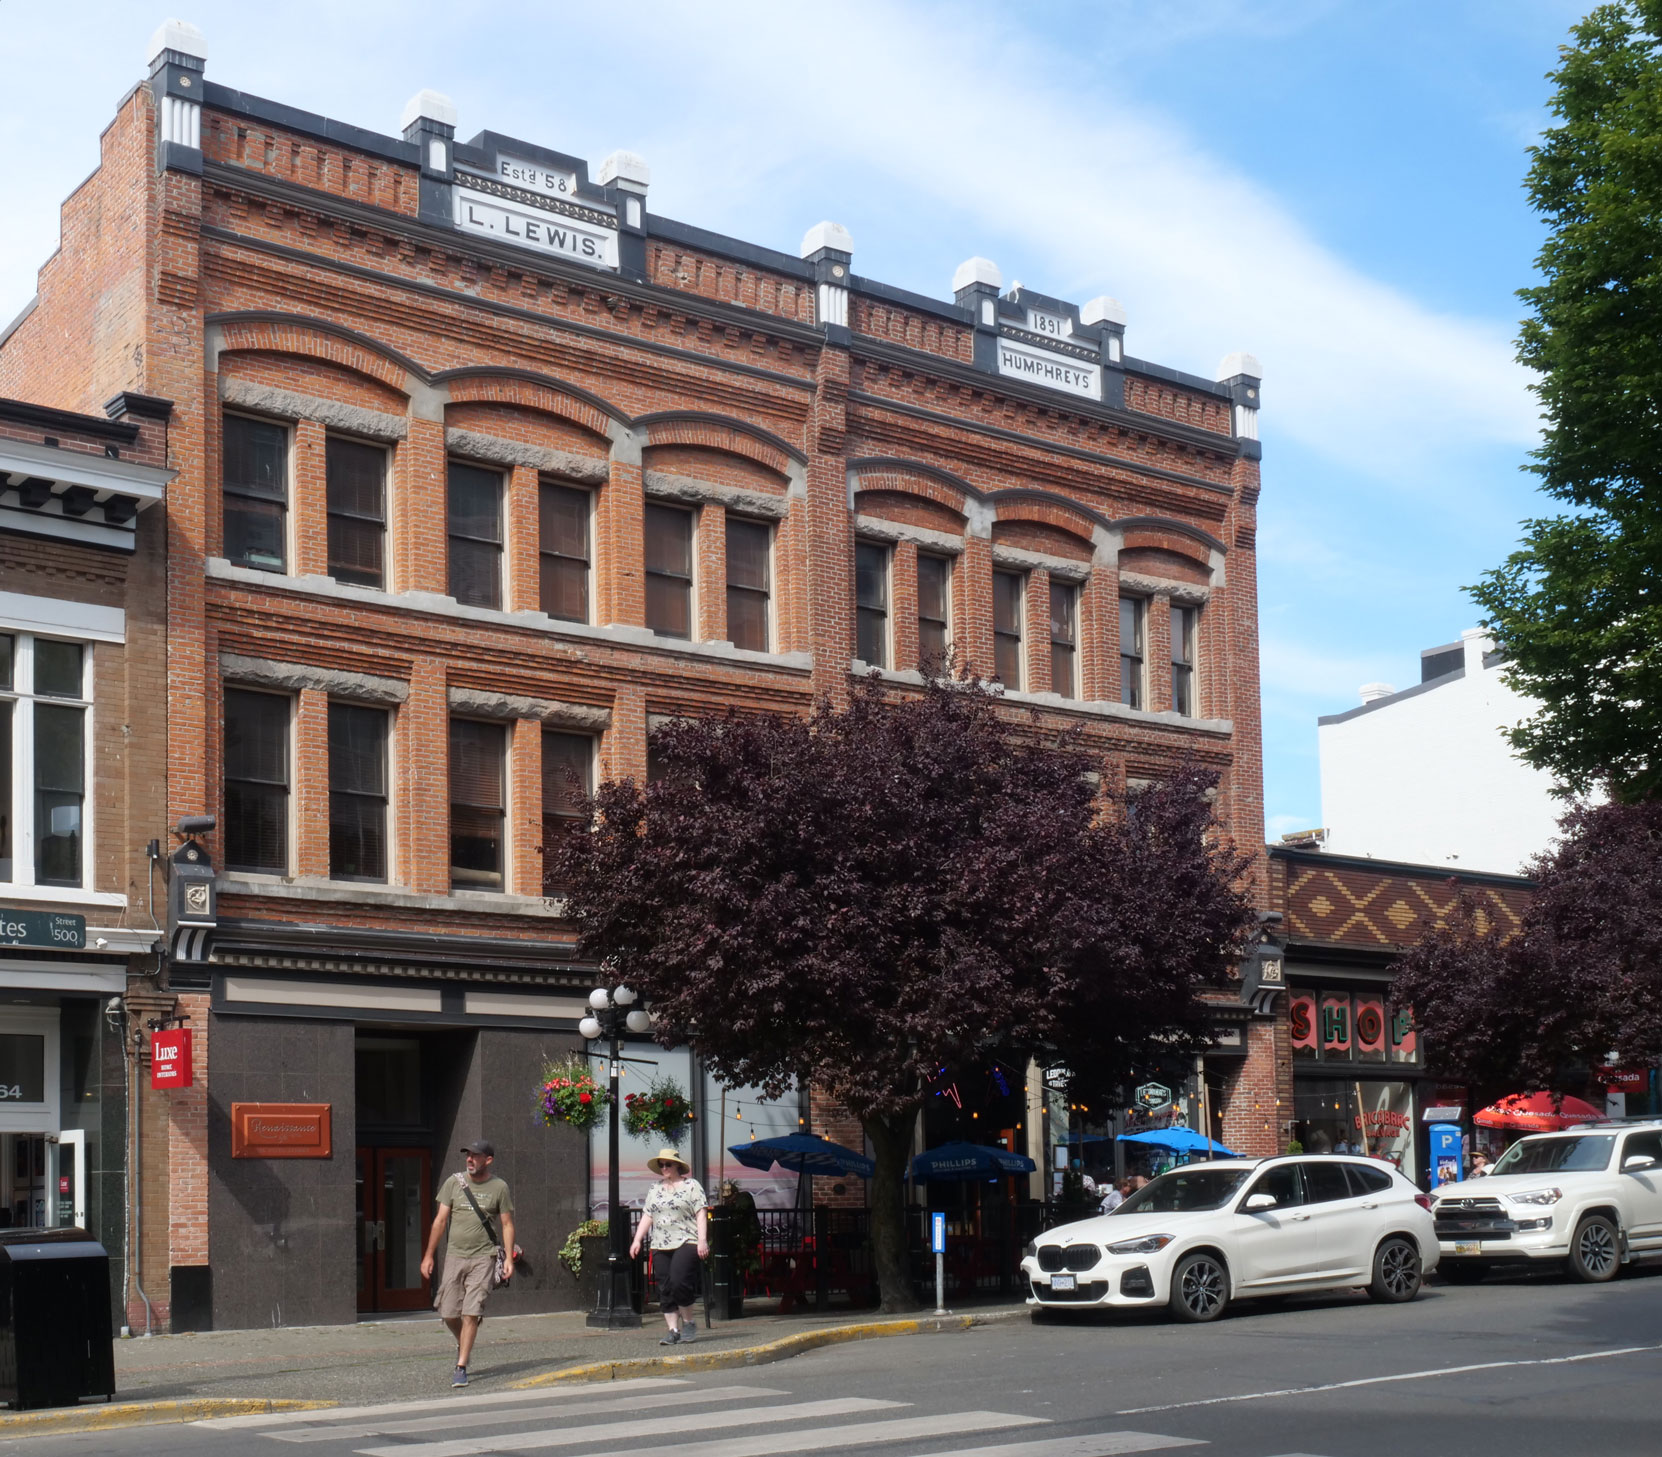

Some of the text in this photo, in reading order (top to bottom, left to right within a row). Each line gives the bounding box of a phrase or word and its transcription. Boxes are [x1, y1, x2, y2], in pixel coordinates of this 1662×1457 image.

[468, 205, 602, 260] L. LEWIS.
[1033, 313, 1061, 335] 1891
[1003, 352, 1089, 389] HUMPHREYS
[55, 917, 76, 926] Street
[54, 930, 78, 942] 500
[1291, 1001, 1413, 1045] SHOP
[155, 1042, 178, 1061] Luxe
[1441, 1135, 1453, 1149] P
[930, 1158, 977, 1168] PHILLIPS
